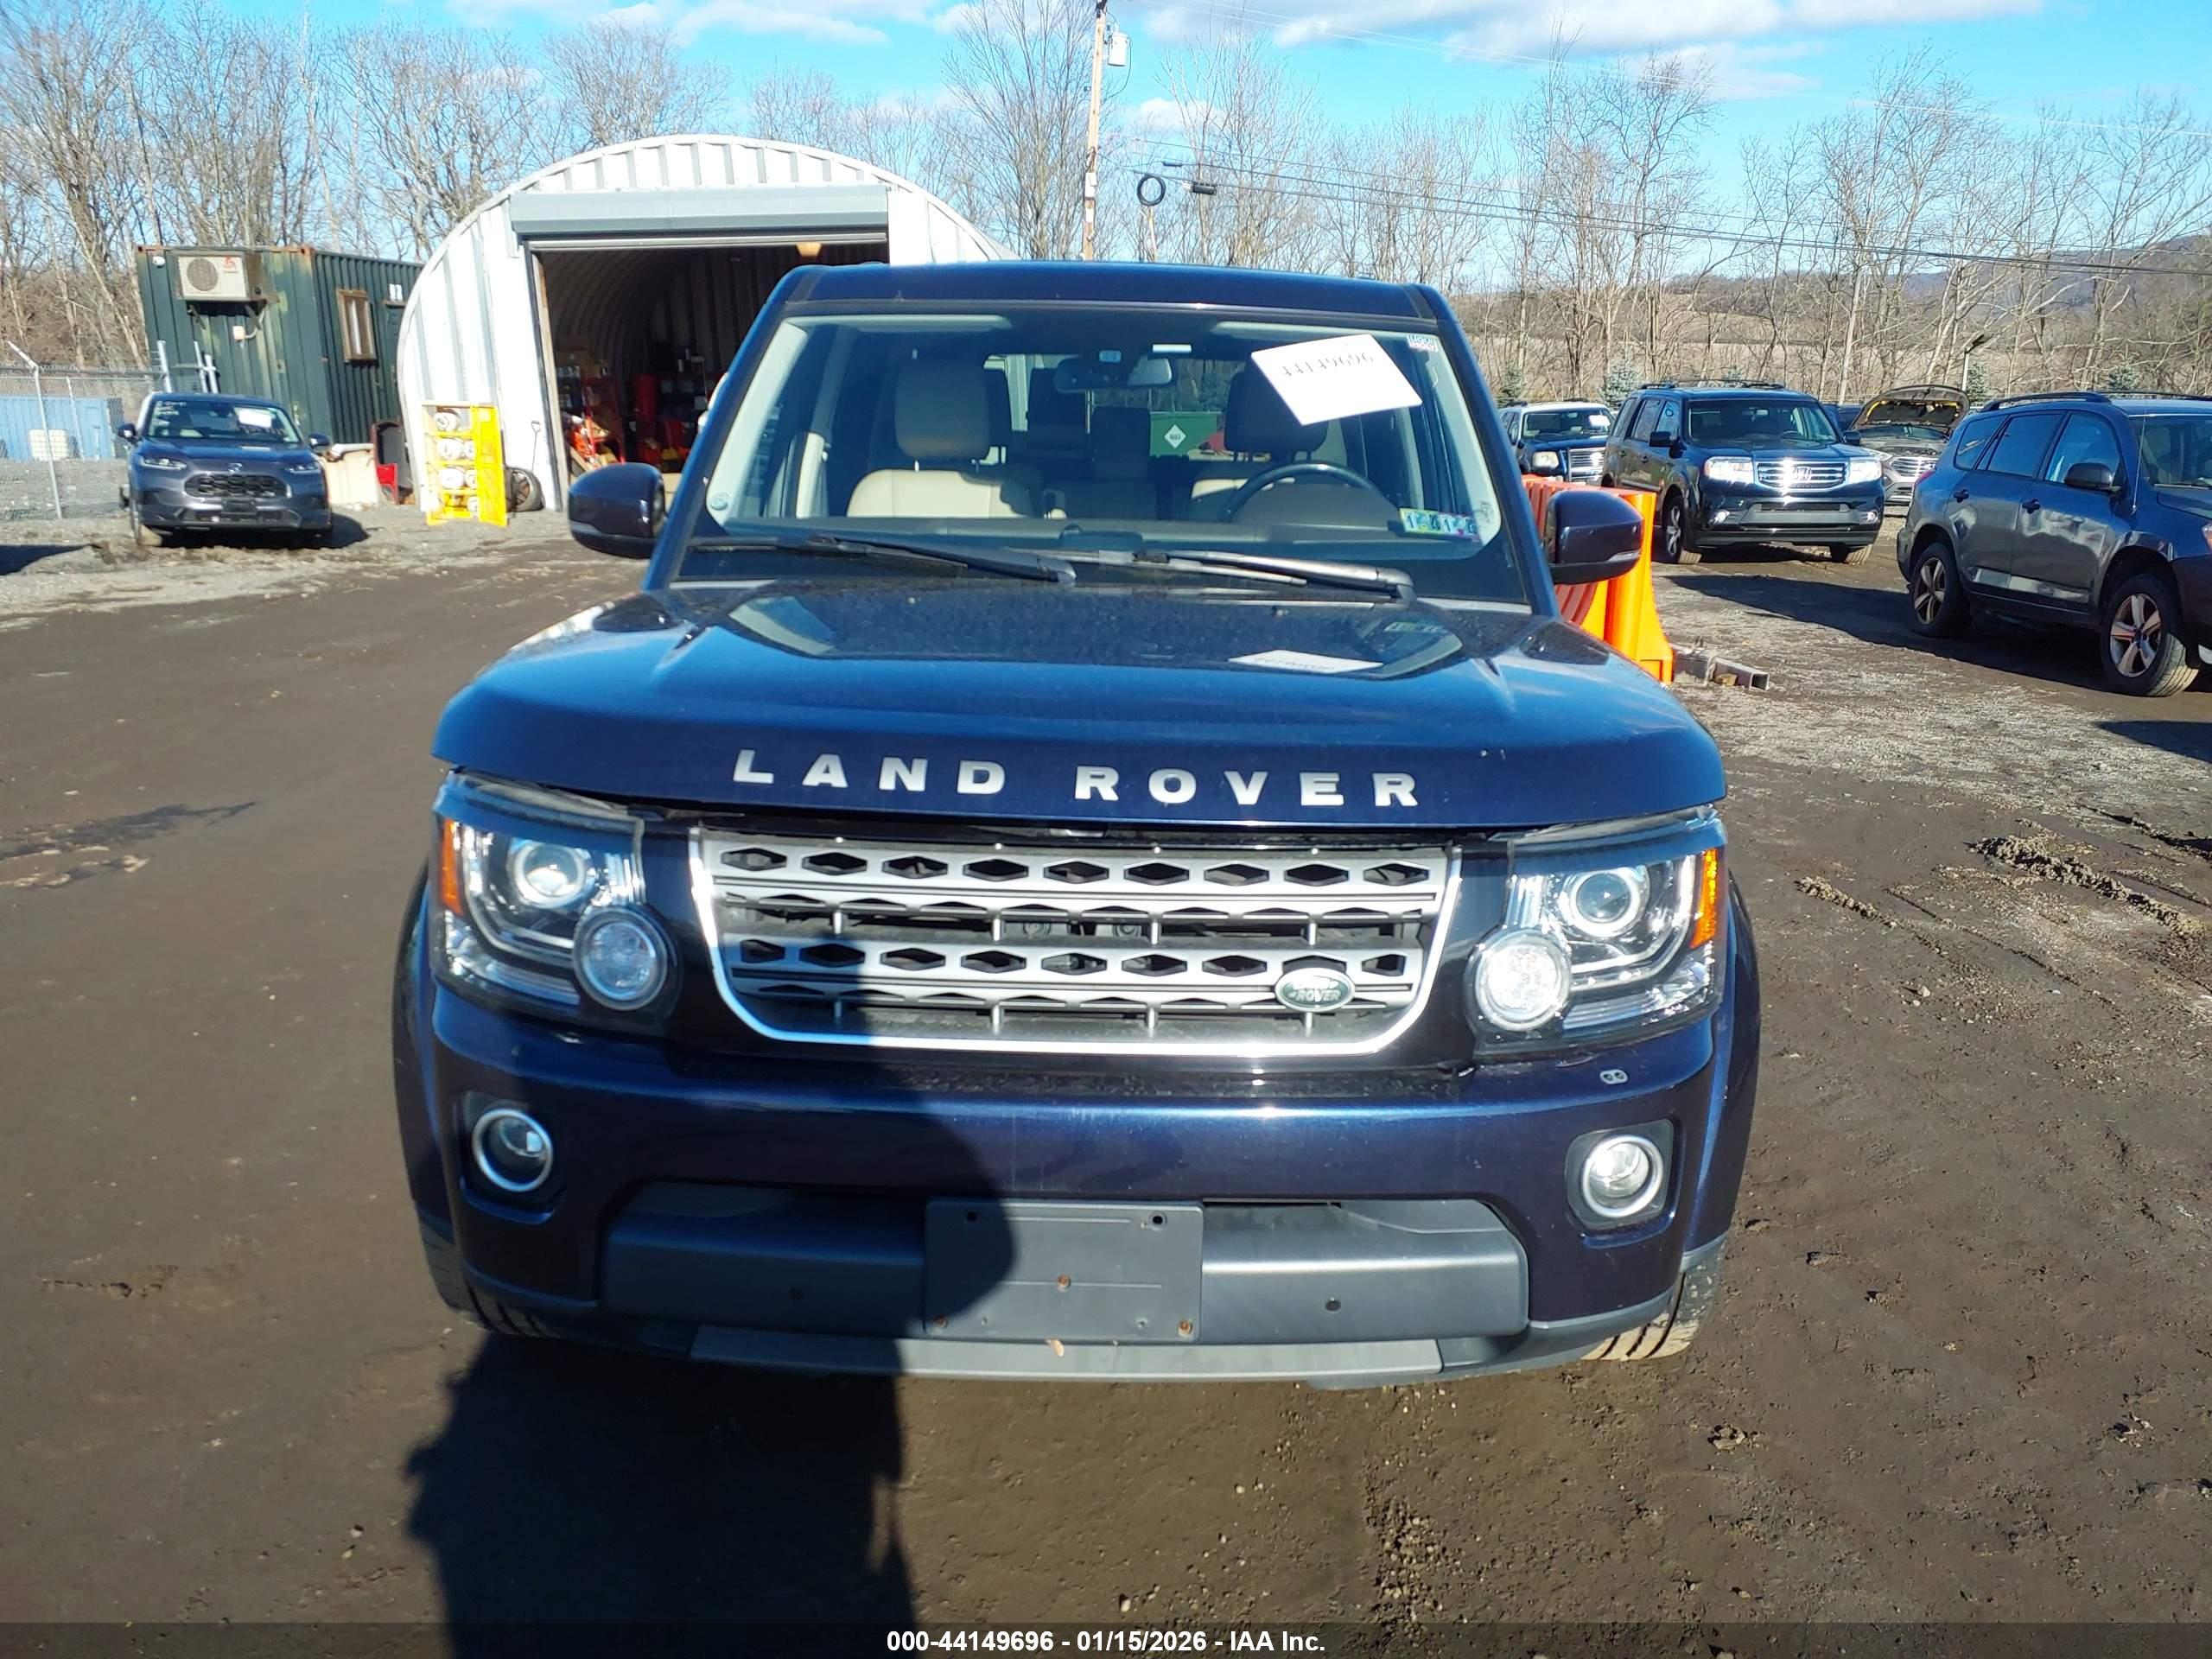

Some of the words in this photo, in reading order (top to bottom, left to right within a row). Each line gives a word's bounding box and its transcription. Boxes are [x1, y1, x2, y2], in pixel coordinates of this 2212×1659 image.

[733, 749, 1006, 795] LAND
[1074, 765, 1420, 809] ROVER
[1295, 988, 1342, 1003] ROVER
